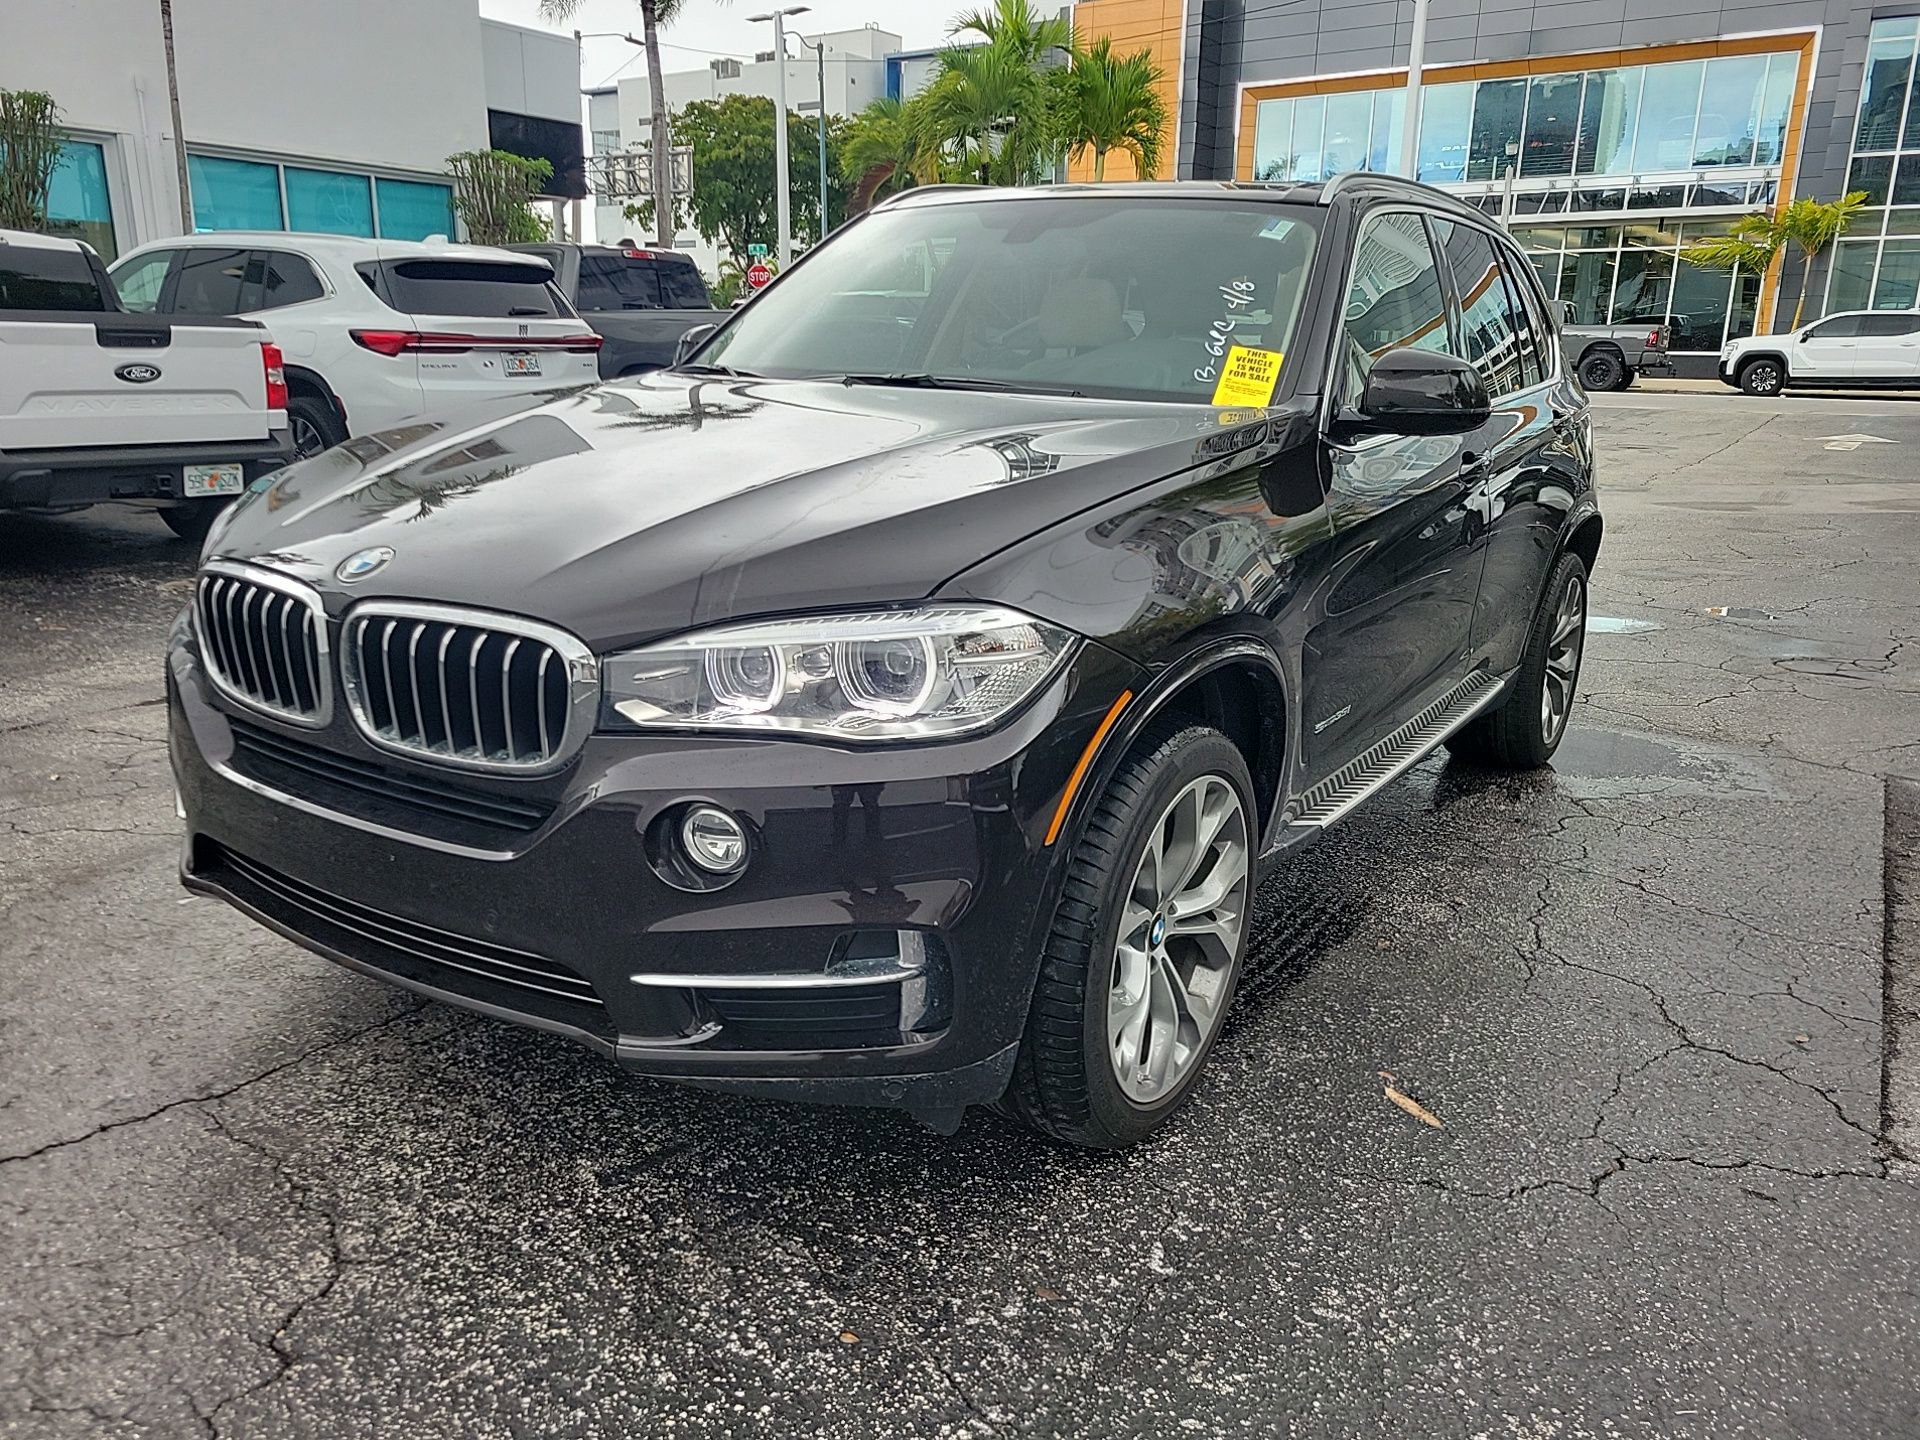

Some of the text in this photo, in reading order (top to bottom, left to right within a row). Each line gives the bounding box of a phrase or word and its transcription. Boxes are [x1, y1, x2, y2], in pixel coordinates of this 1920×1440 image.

[750, 271, 769, 281] STOP
[1247, 350, 1268, 360] THIS
[1236, 355, 1273, 368] VEHICLE
[130, 368, 151, 378] Ford
[1237, 363, 1267, 375] IS NOT
[1229, 370, 1271, 383] FOR SALE
[38, 397, 232, 413] MAVERICK
